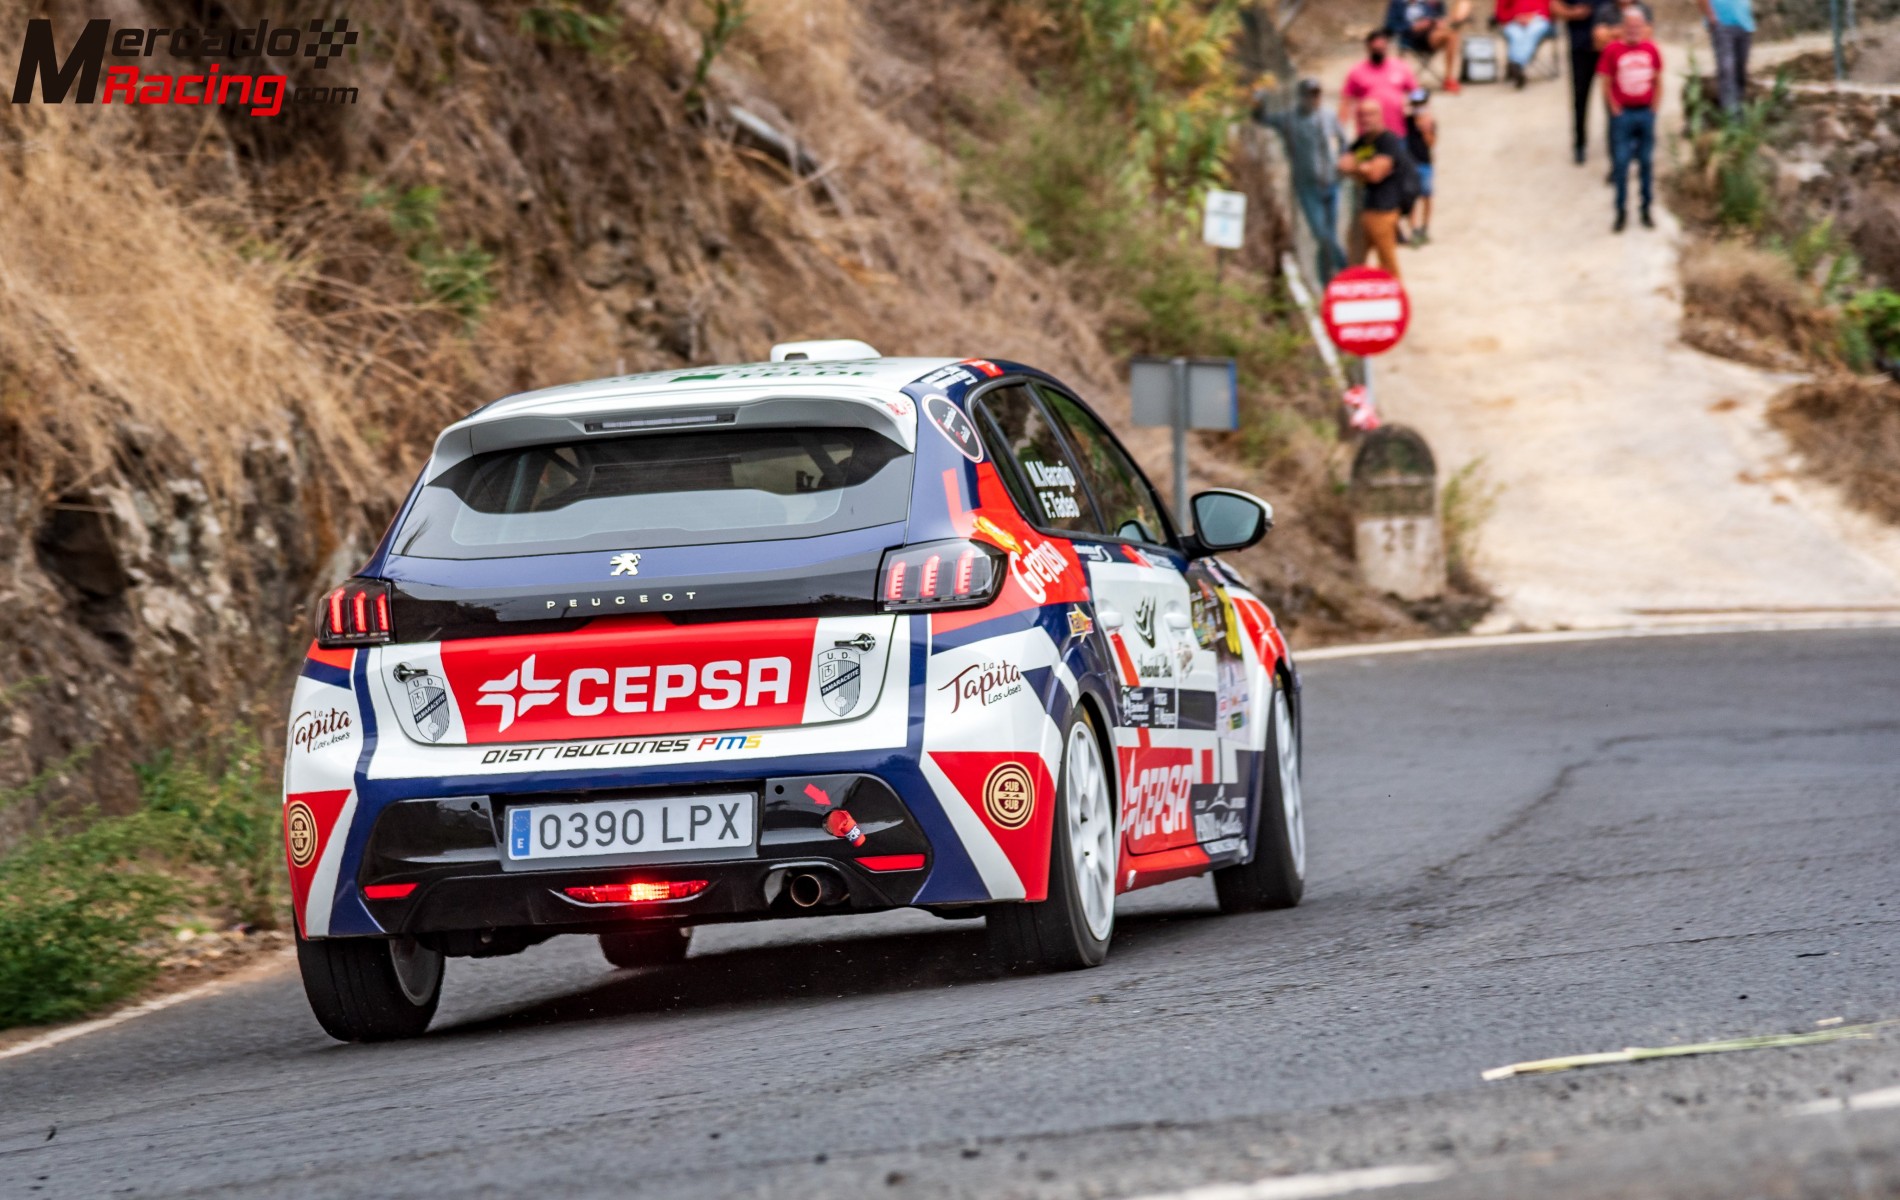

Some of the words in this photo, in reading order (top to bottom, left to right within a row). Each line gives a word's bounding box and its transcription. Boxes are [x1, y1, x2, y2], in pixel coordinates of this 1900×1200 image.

[546, 591, 696, 609] PEUGEOT
[566, 656, 792, 717] CEPSA
[937, 660, 1021, 714] Tapita
[289, 707, 352, 760] Tapita
[1004, 781, 1020, 791] SUB
[1004, 800, 1020, 810] SUB
[1133, 765, 1193, 840] CEPSA
[517, 837, 525, 849] E
[539, 809, 645, 851] 0390
[661, 802, 741, 844] LPX
